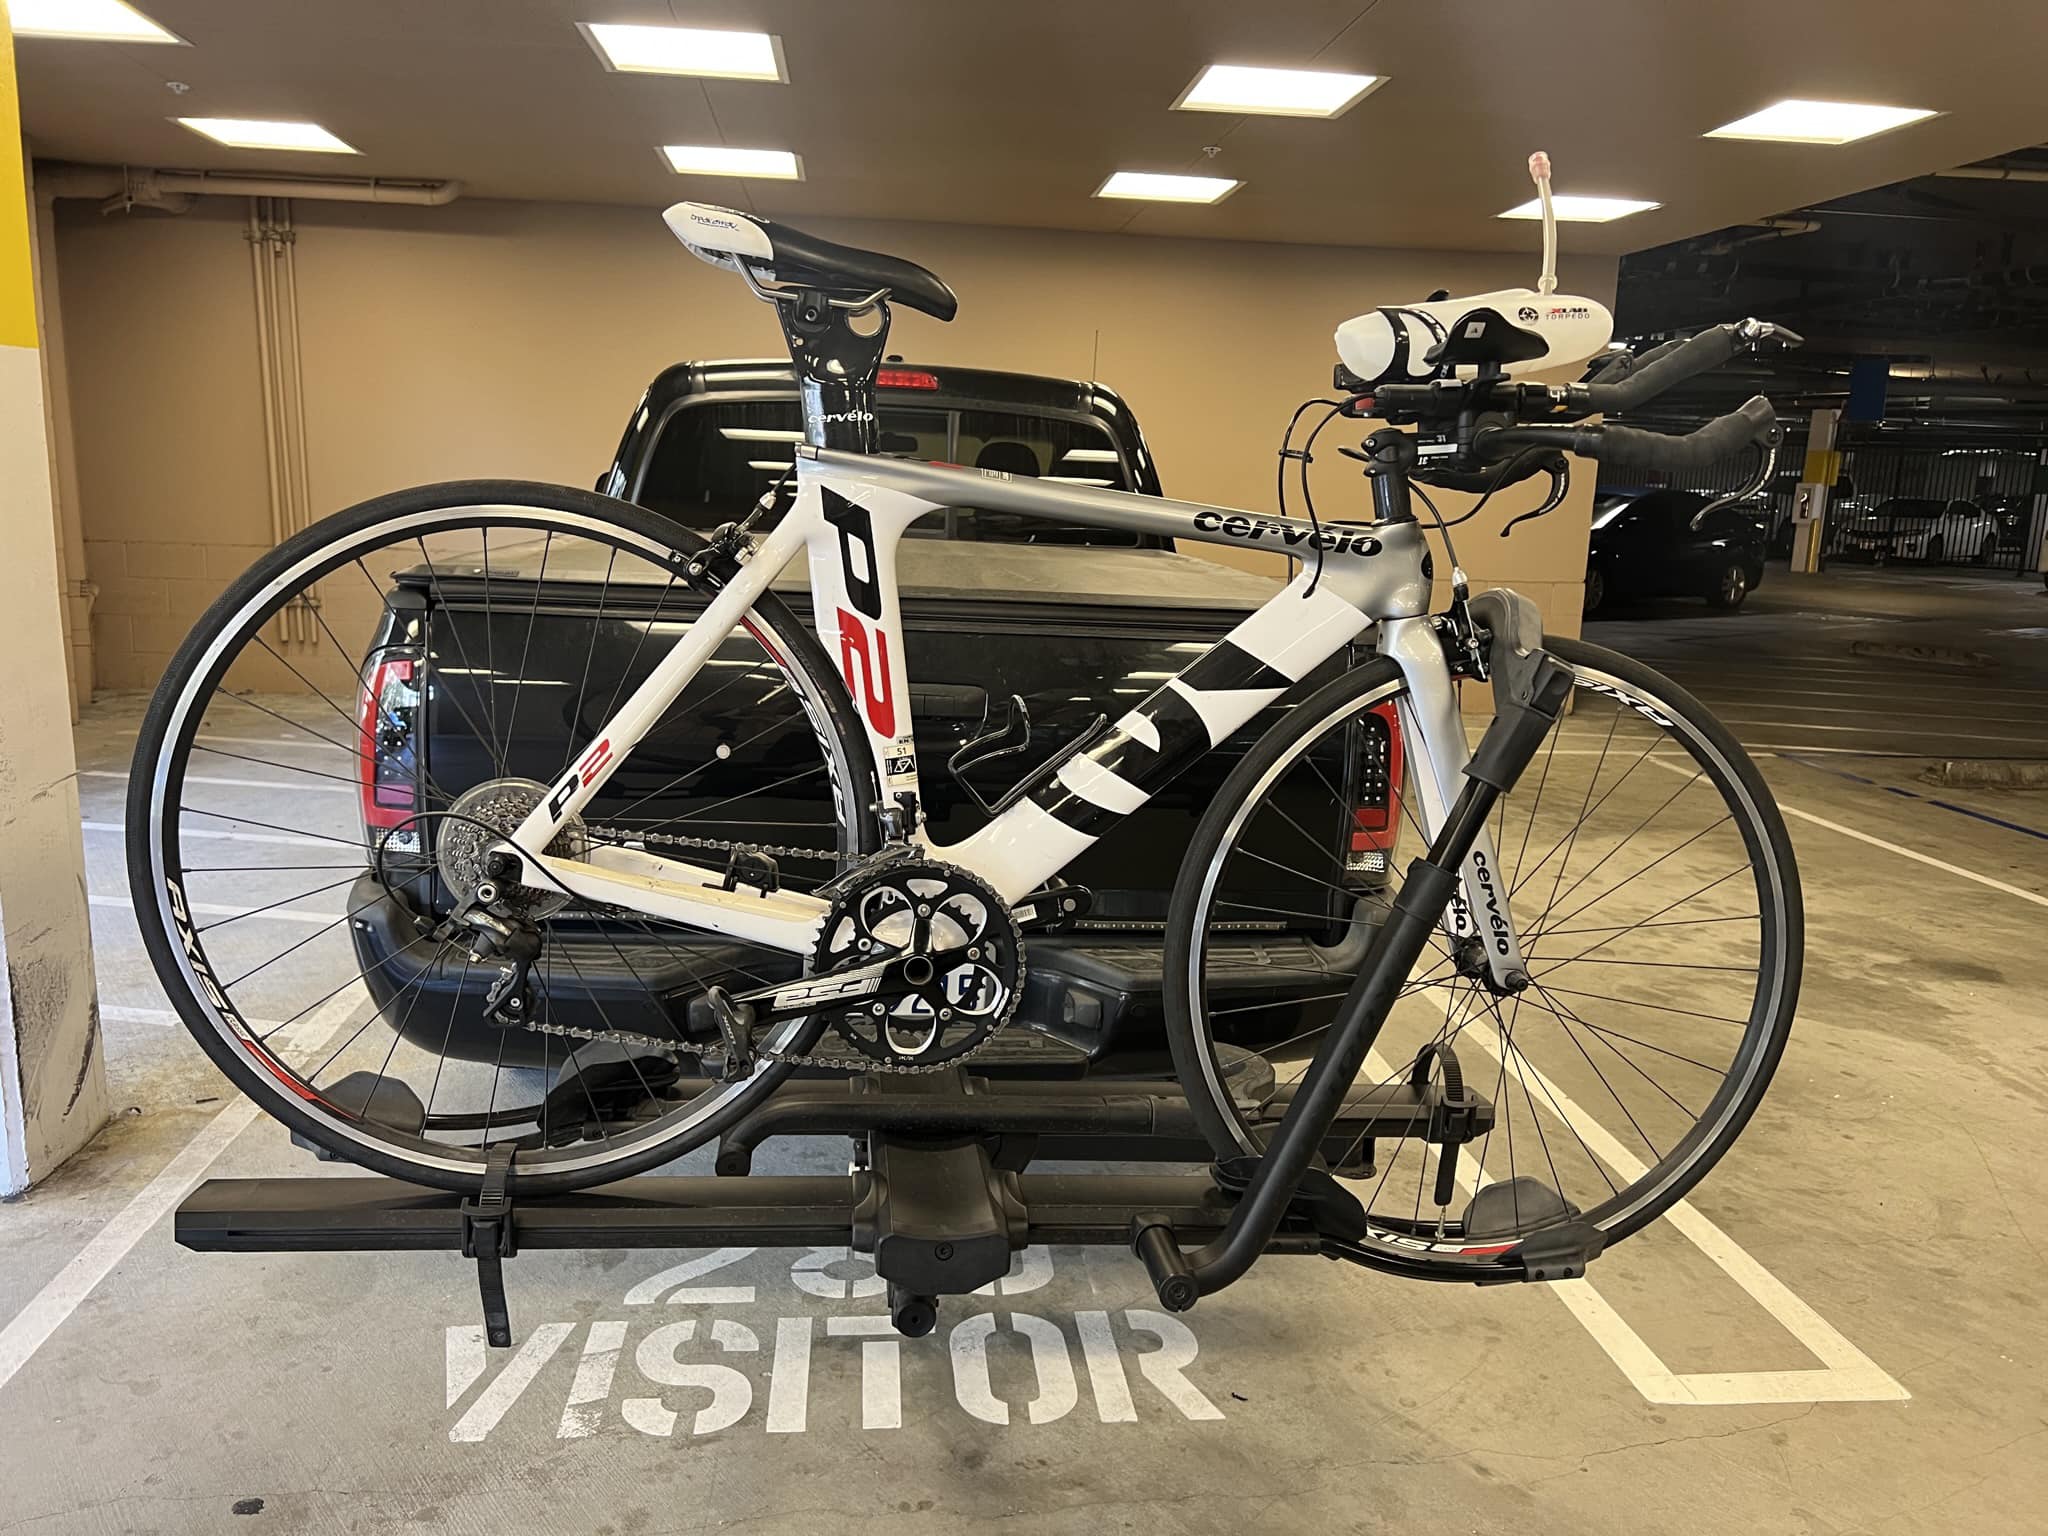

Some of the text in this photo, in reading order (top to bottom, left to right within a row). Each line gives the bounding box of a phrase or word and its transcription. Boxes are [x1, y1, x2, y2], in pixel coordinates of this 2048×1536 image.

[807, 409, 874, 423] cervélo
[1193, 511, 1383, 557] cervélo
[548, 738, 613, 825] P2
[896, 747, 908, 756] 51
[166, 876, 230, 1011] AXIS
[1472, 850, 1510, 956] cervélo
[445, 1308, 1227, 1443] VISITOR
